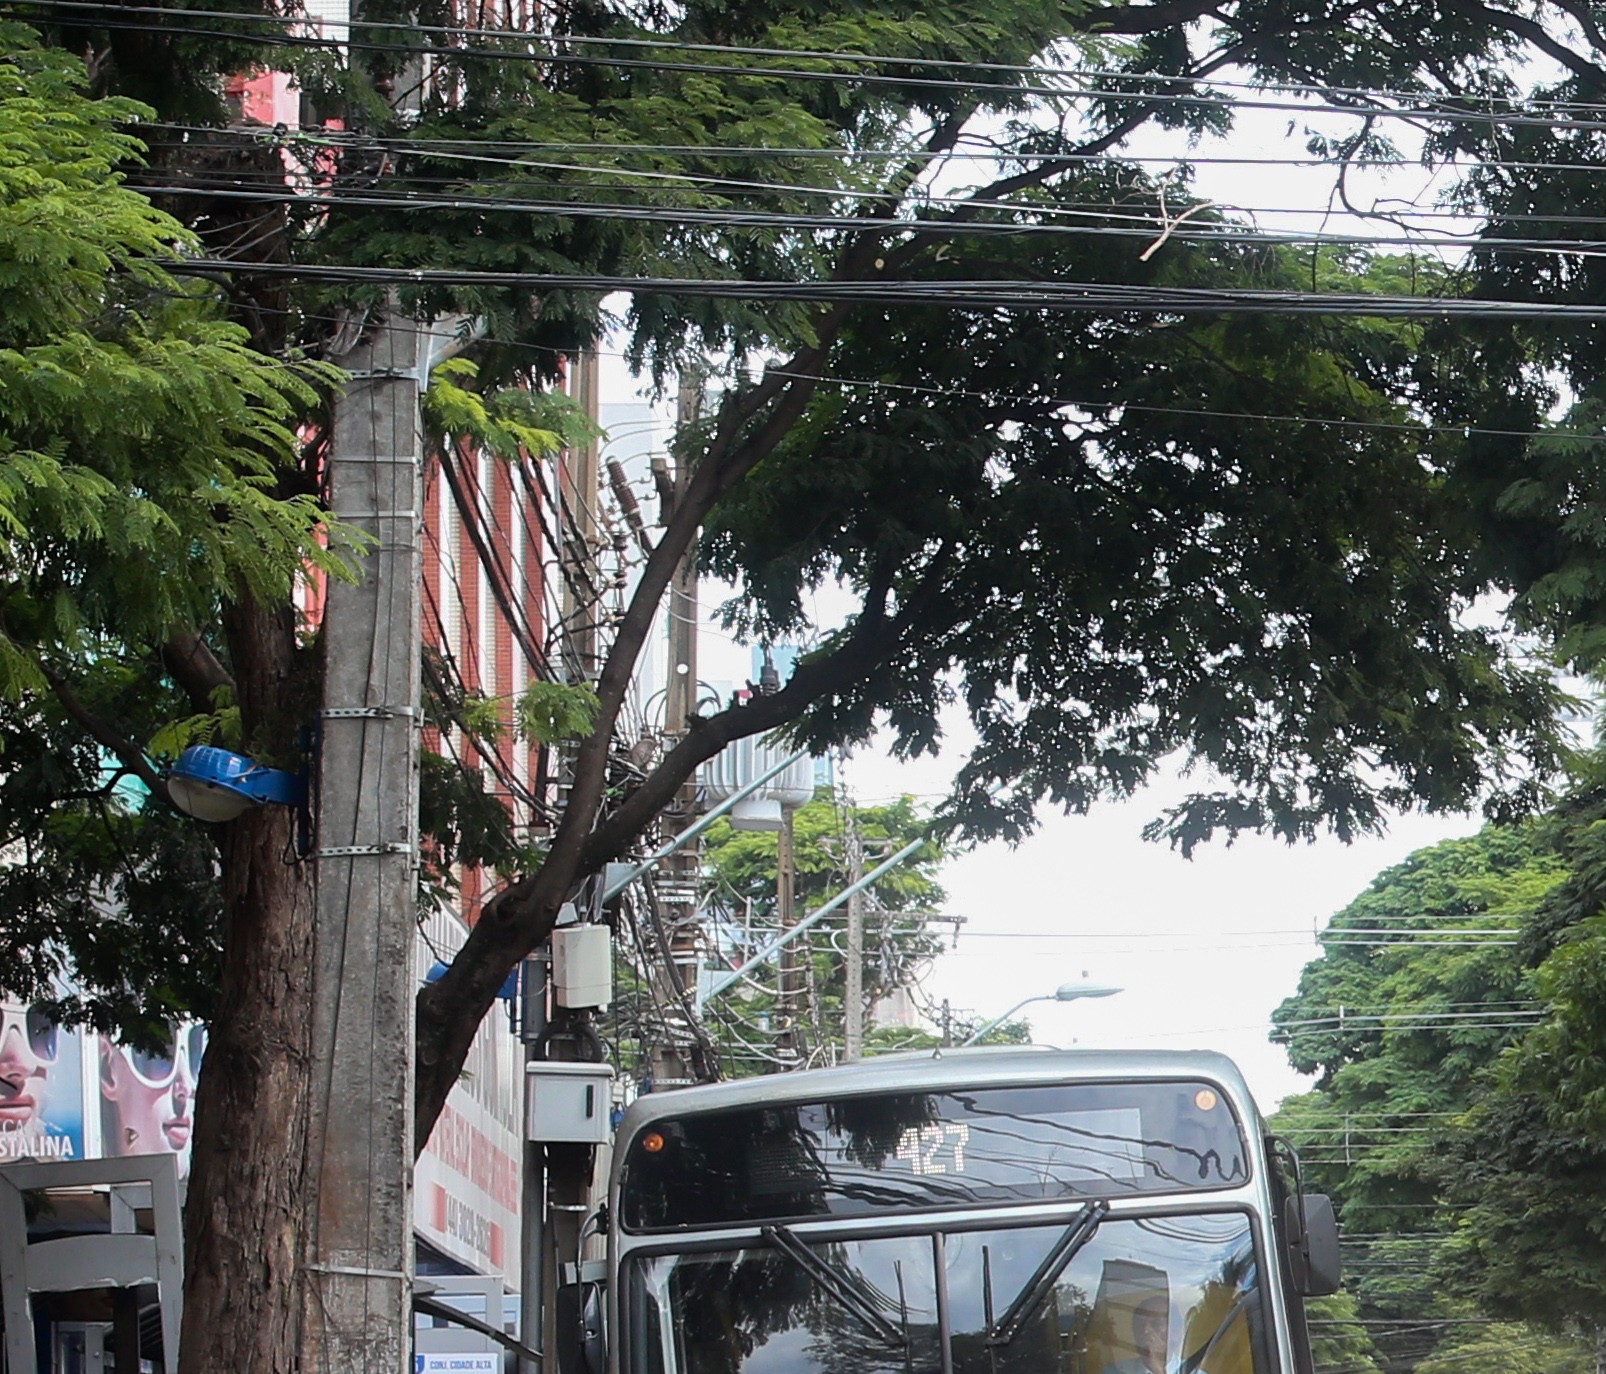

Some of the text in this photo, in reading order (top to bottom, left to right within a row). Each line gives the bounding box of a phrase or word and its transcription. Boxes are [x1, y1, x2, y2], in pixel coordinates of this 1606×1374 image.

[896, 1123, 970, 1175] 427
[450, 1360, 474, 1370] CIDADE
[476, 1360, 492, 1370] ALTA
